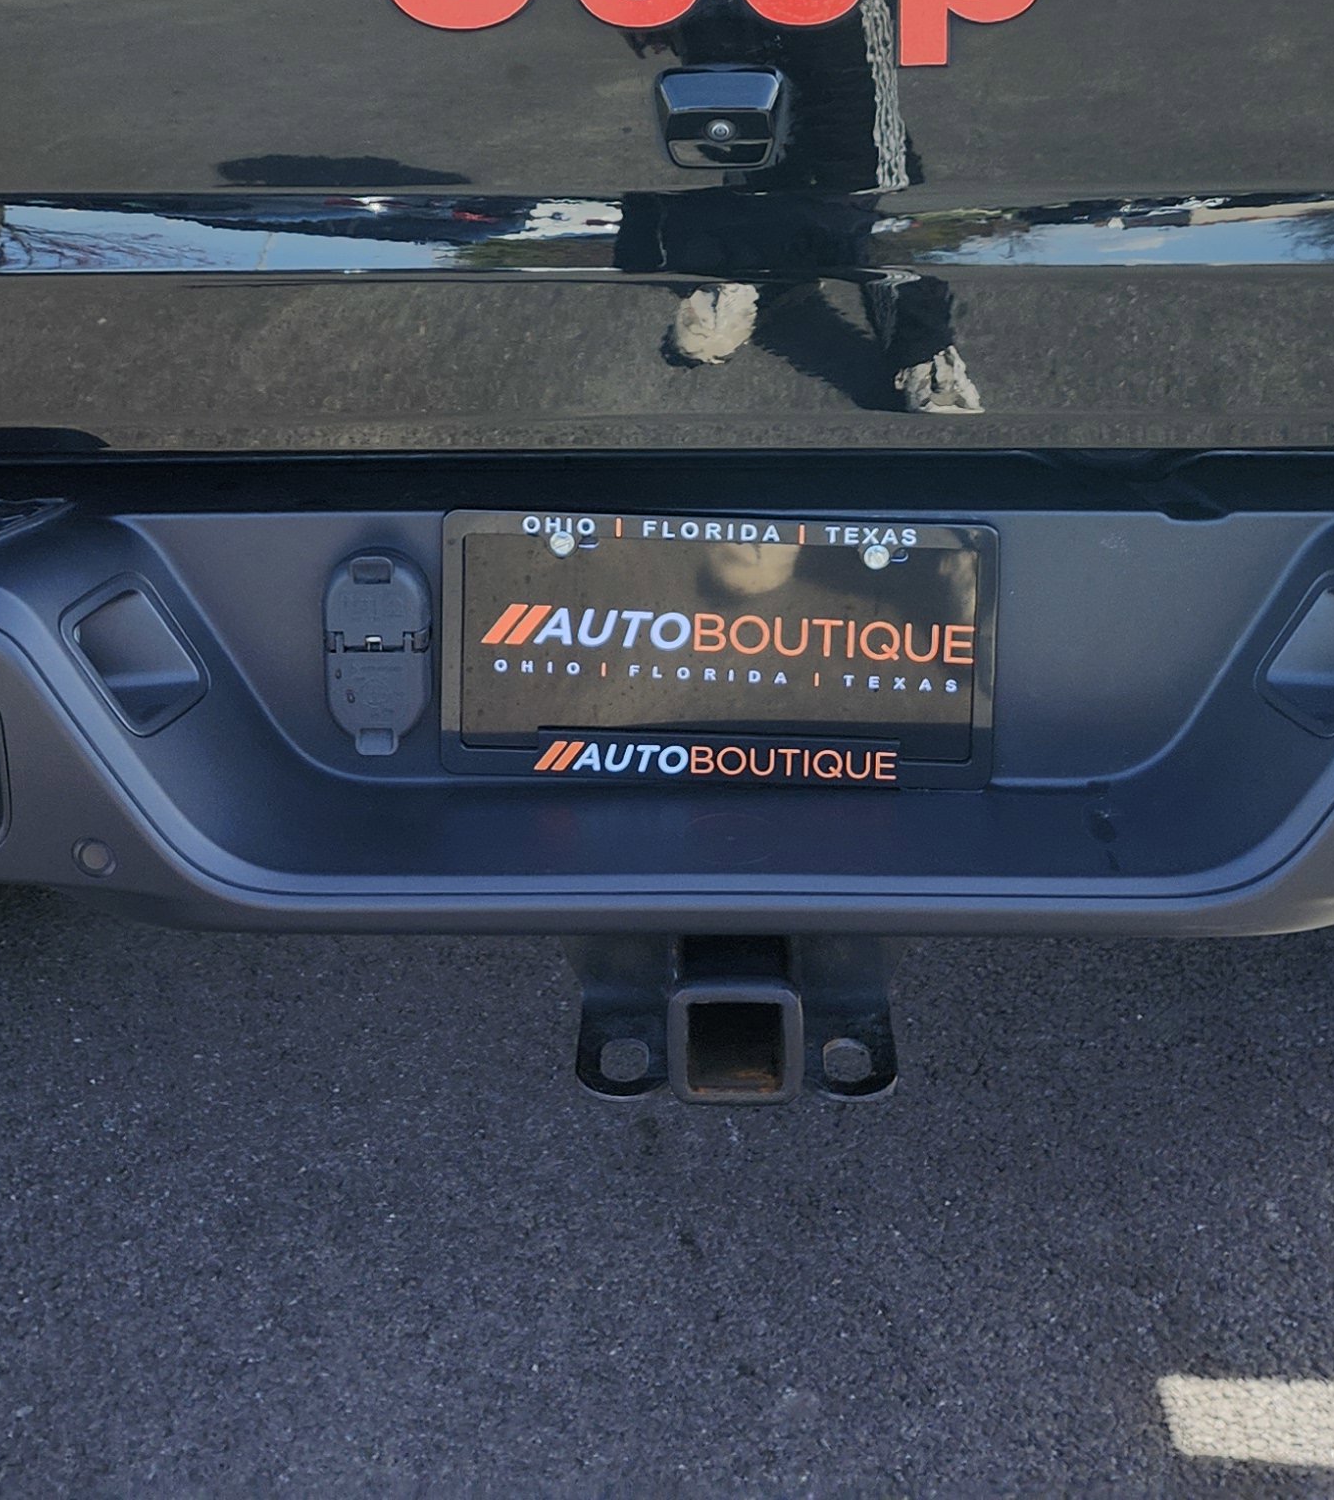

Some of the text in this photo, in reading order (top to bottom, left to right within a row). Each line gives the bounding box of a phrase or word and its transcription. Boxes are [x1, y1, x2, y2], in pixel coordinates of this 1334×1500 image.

[522, 515, 918, 547] OHIO FLORIDA TEXAS
[533, 606, 975, 665] AUTOBOUTIQUE
[493, 658, 959, 692] OHIO FLORIDA TEXAS
[572, 742, 898, 781] AUTOBOUTIQUE
